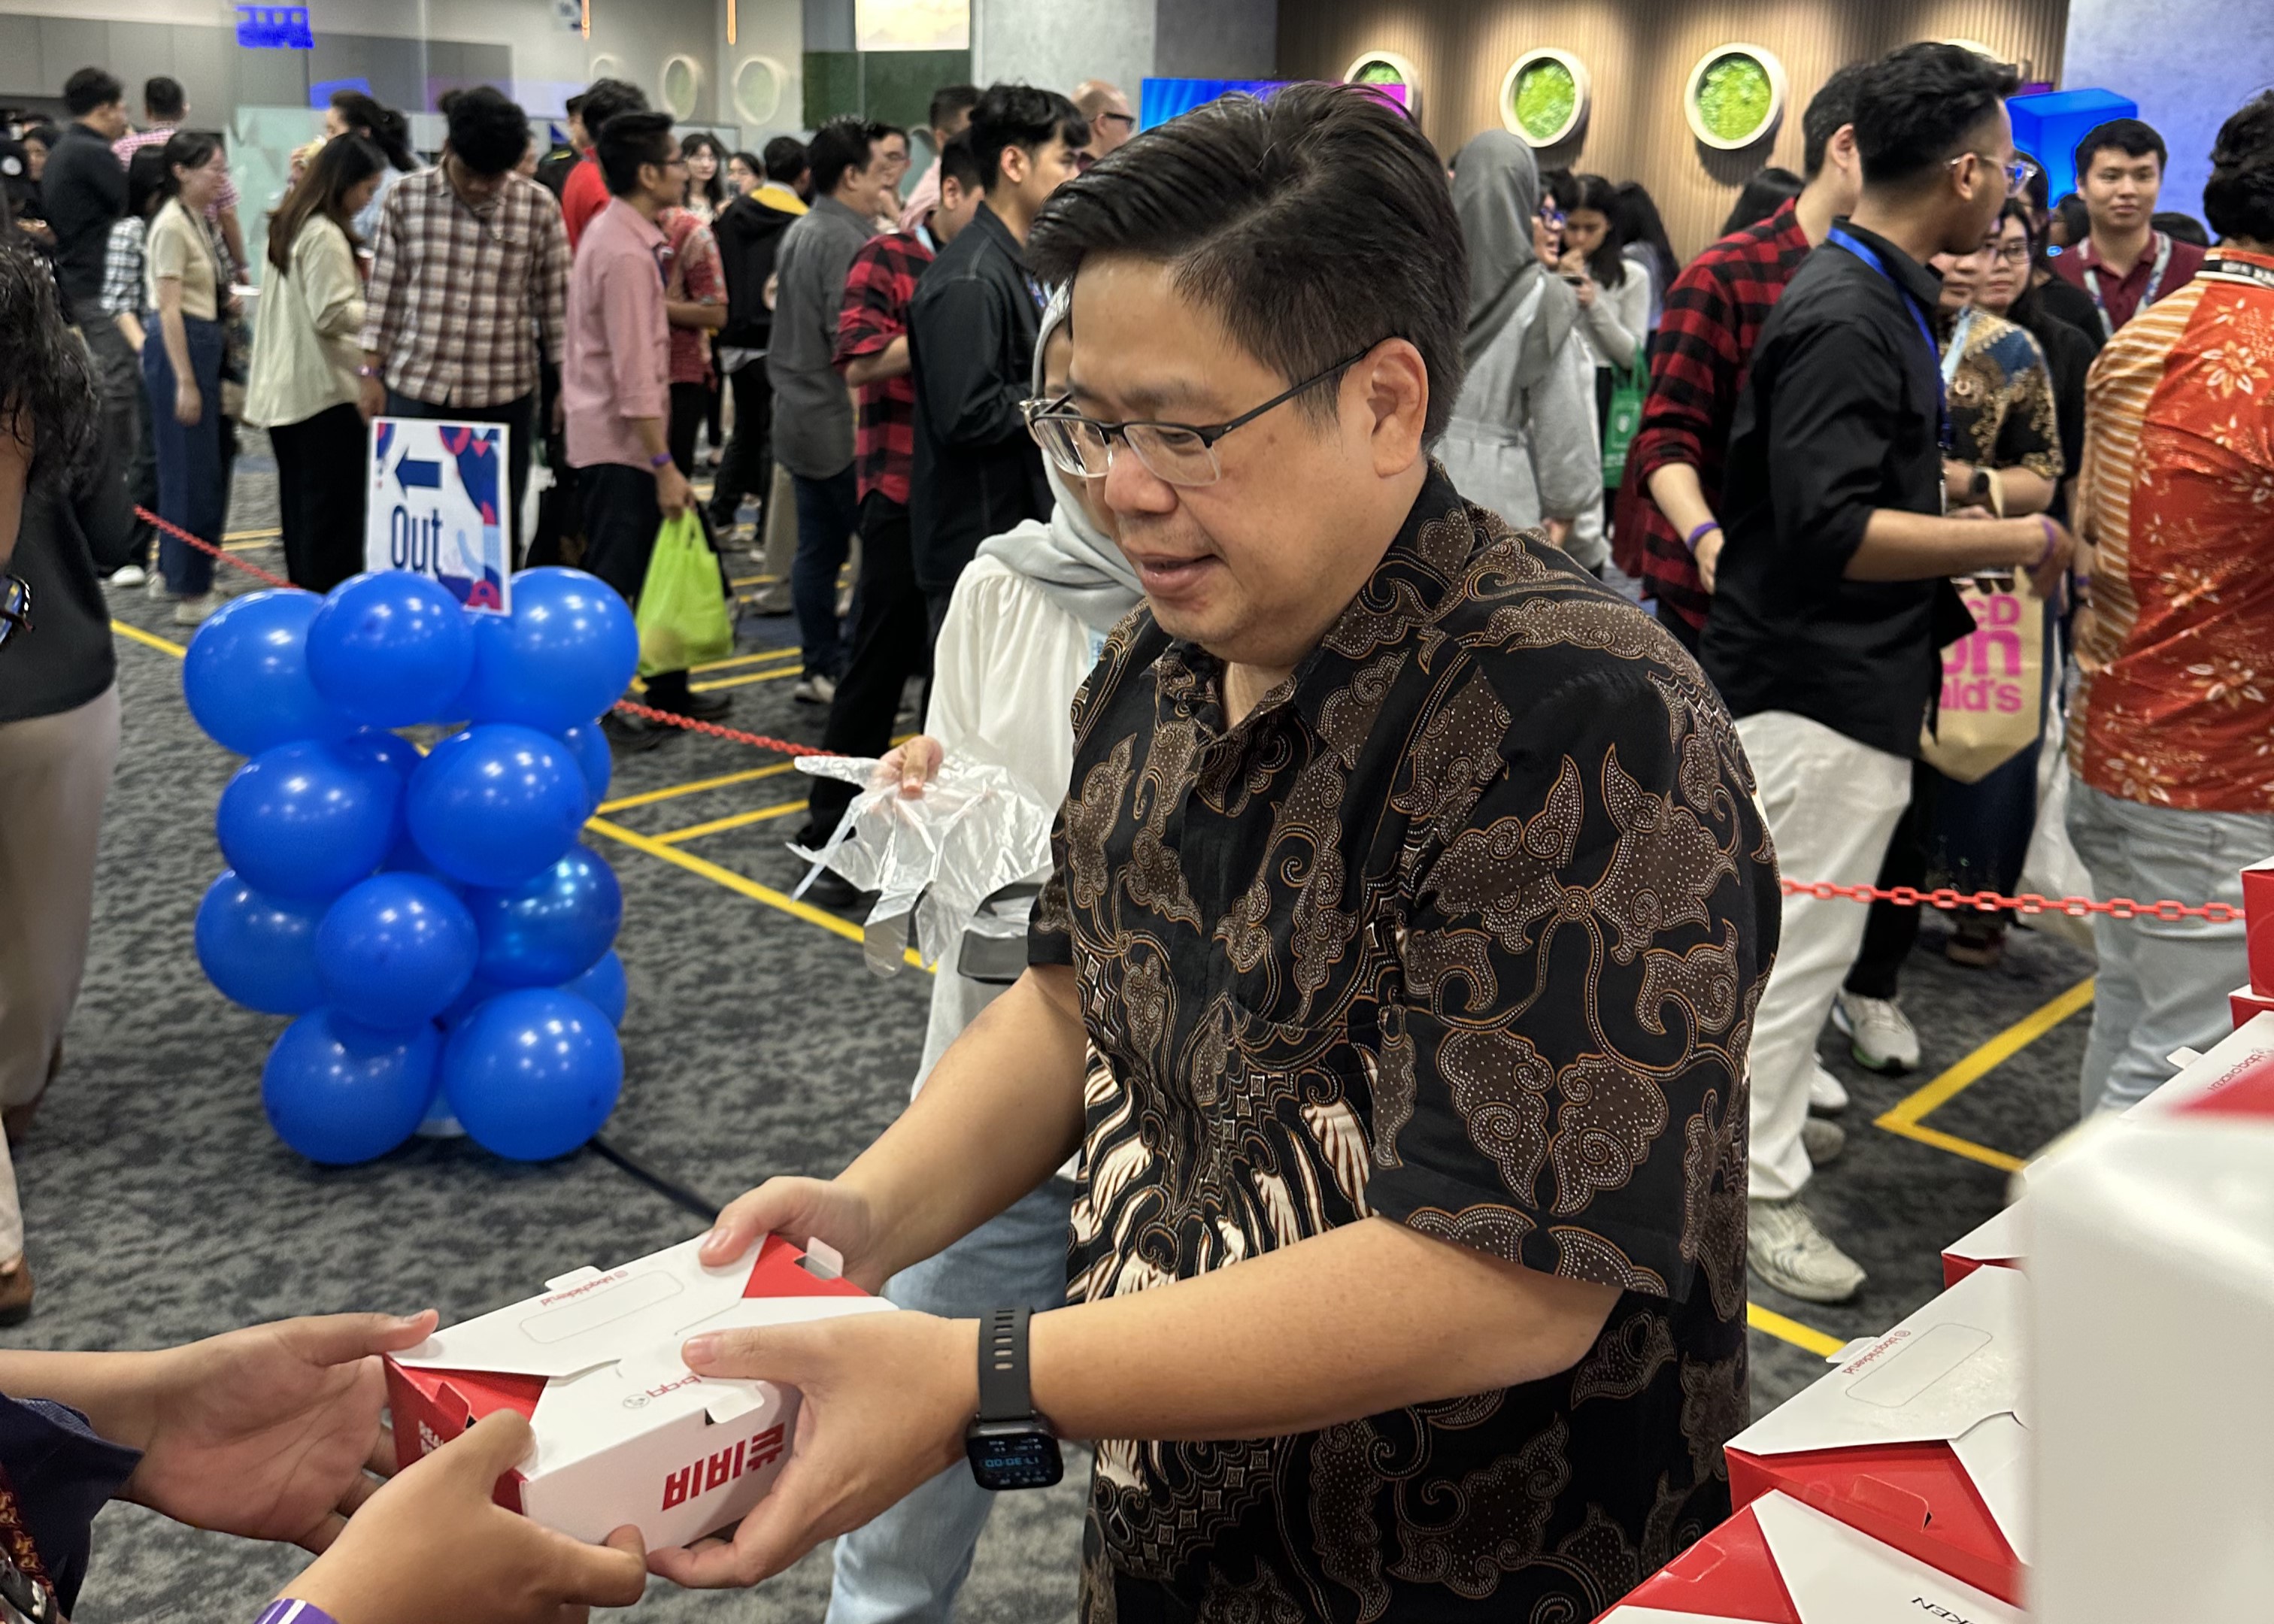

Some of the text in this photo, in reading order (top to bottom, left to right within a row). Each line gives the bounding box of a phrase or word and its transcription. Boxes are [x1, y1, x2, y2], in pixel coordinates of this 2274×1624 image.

[391, 504, 442, 576] Out
[661, 1422, 785, 1511] 비비큐
[1911, 1597, 1975, 1624] KEN
